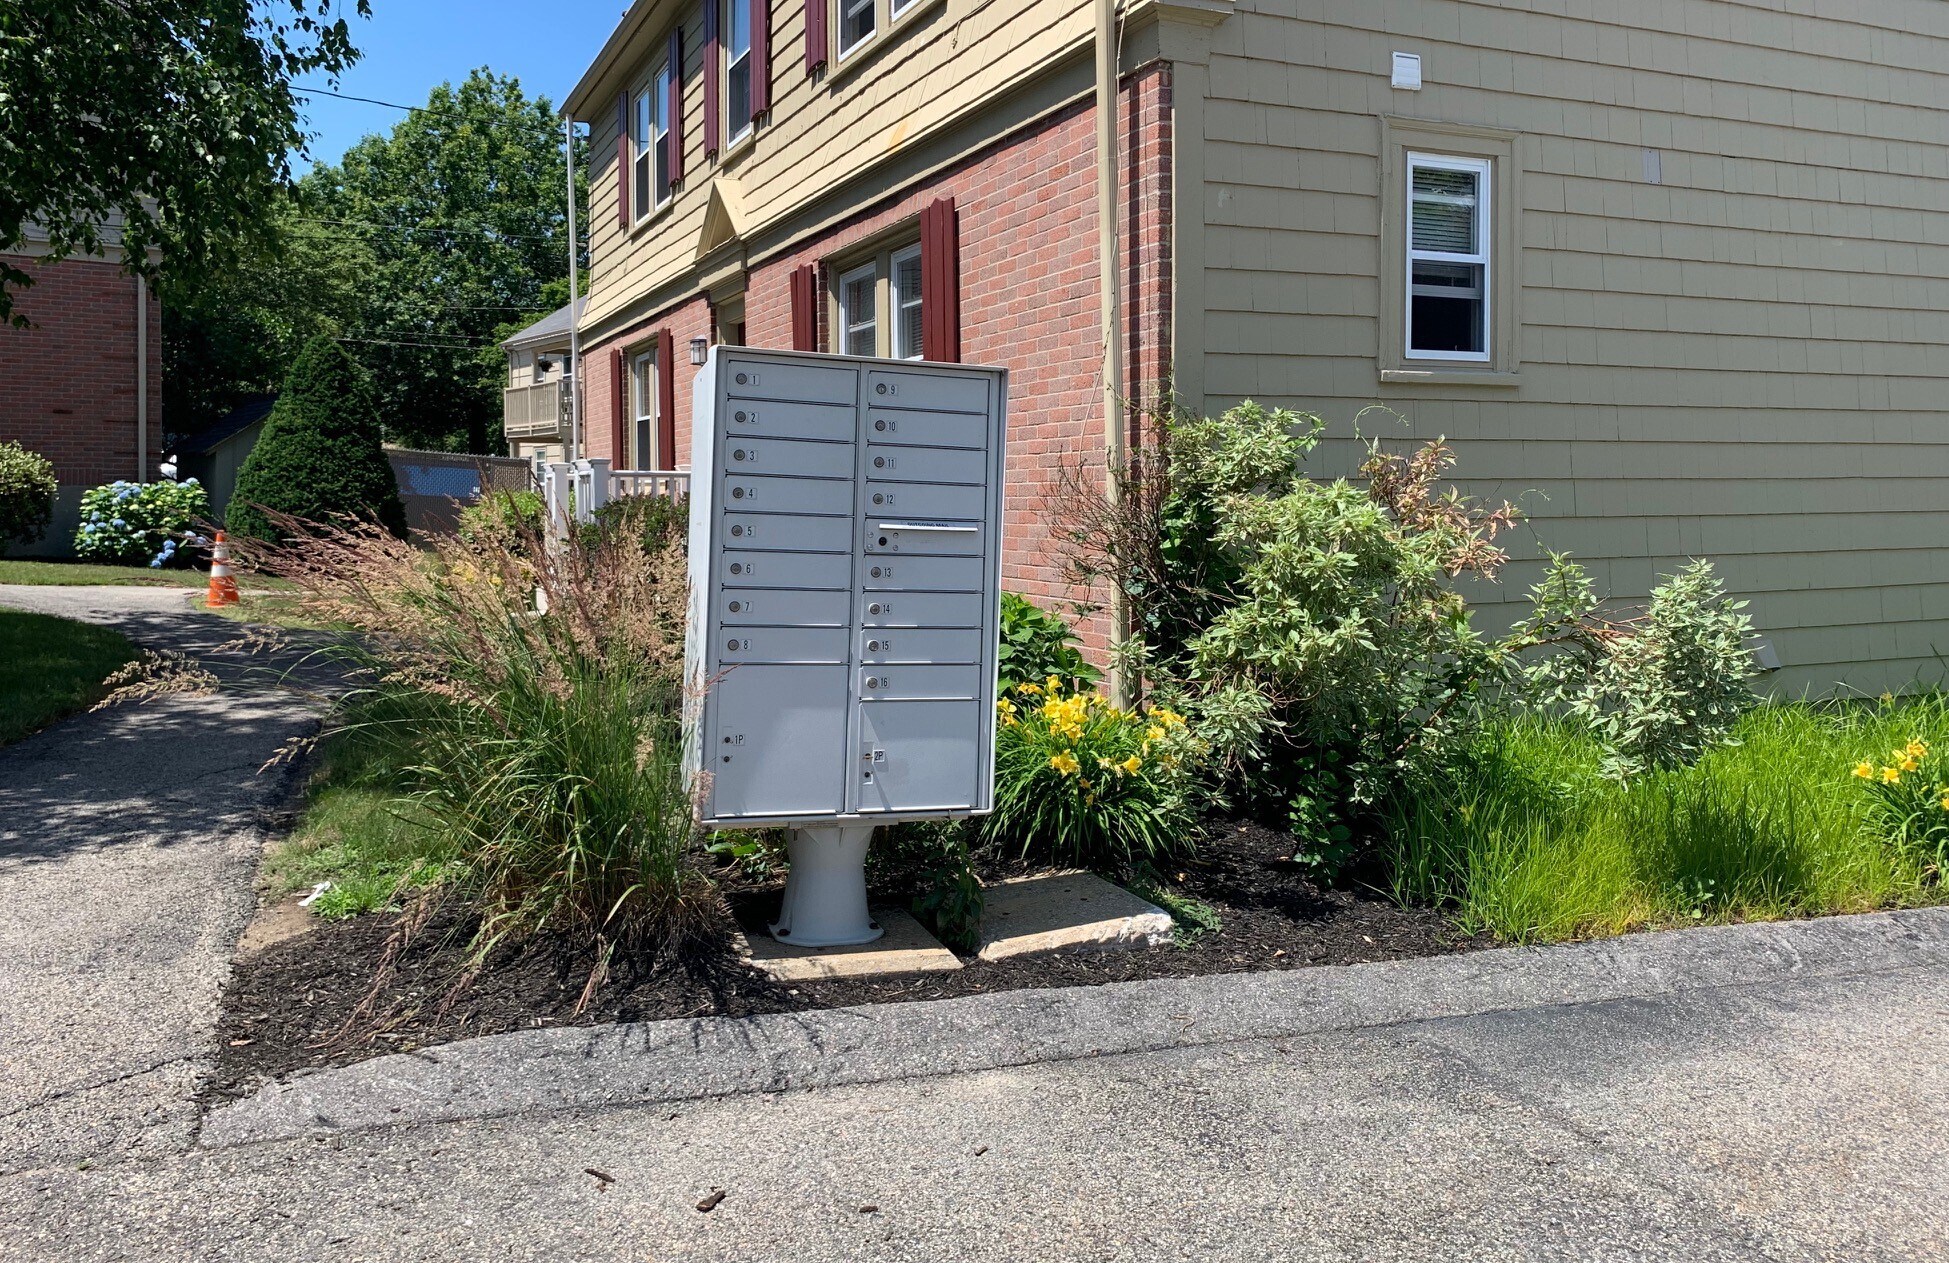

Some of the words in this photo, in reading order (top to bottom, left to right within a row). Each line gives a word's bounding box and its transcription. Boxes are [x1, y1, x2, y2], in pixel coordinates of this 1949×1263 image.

[752, 376, 756, 384] 1
[890, 385, 896, 395] 9
[751, 412, 756, 422] 2
[889, 422, 896, 431] 10
[750, 450, 756, 460] 3
[888, 458, 894, 468] 11
[748, 488, 754, 498] 4
[886, 494, 894, 504] 12
[747, 526, 752, 536] 5
[746, 564, 752, 574] 6
[884, 568, 892, 578] 13
[745, 602, 750, 612] 7
[883, 605, 891, 614] 14
[744, 640, 749, 650] 8
[882, 642, 890, 650] 15
[880, 678, 888, 688] 16
[734, 735, 744, 745] 1P
[874, 751, 884, 762] 2P
